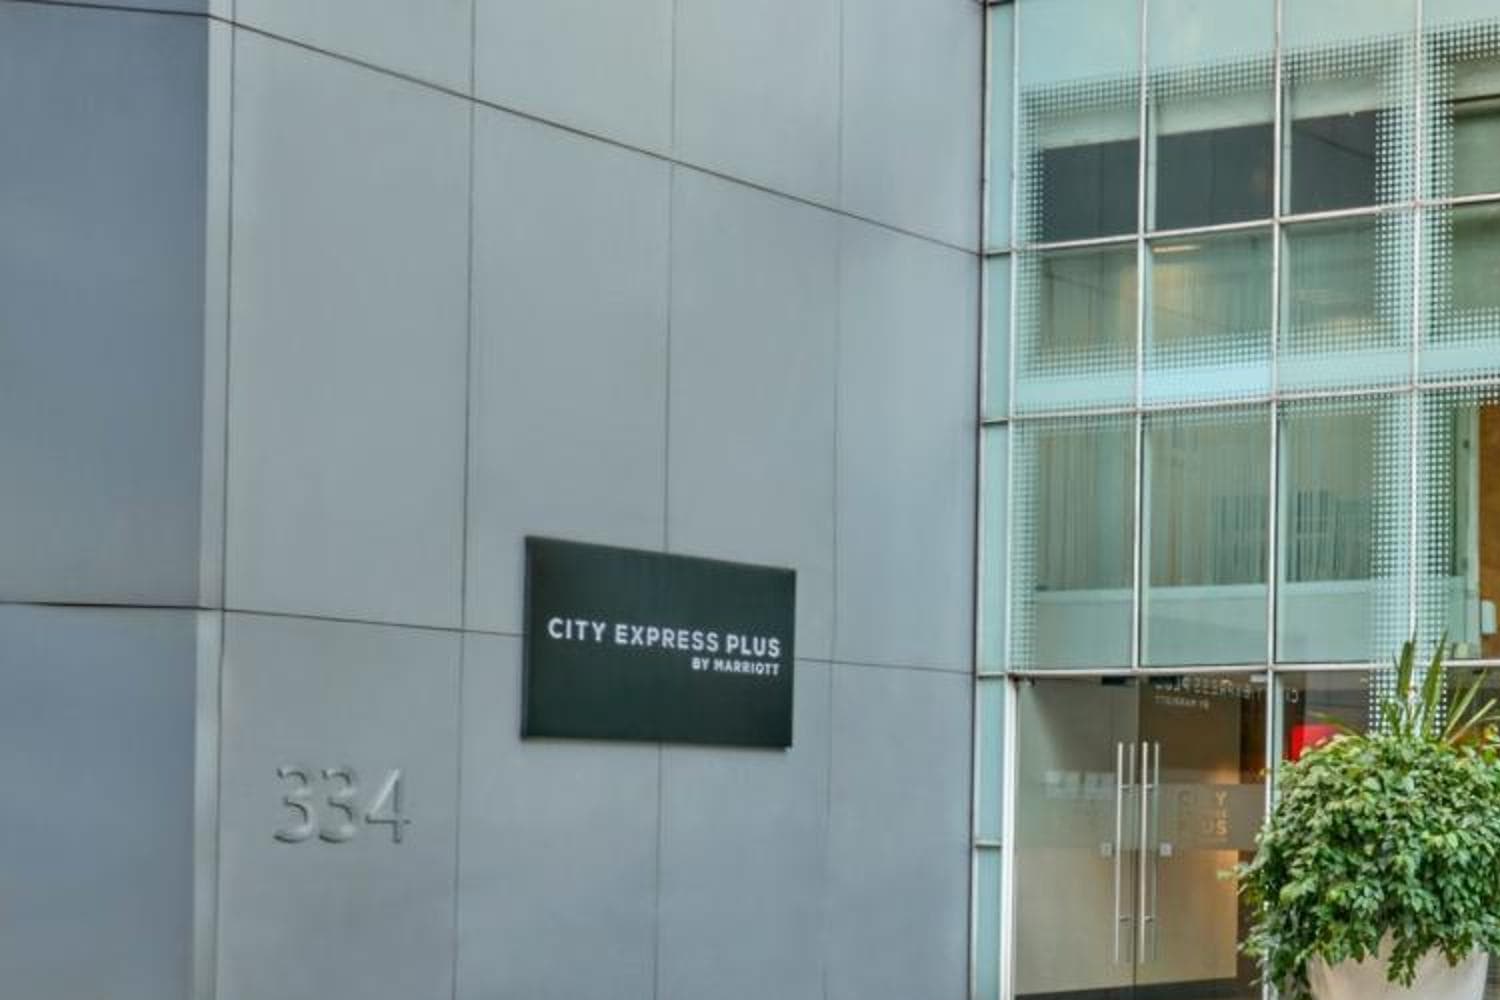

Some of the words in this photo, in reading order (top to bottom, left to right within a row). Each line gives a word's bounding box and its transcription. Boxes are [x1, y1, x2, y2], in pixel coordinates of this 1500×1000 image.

[547, 617, 606, 643] CITY
[615, 623, 719, 652] EXPRESS
[725, 634, 781, 658] PLUS
[691, 657, 709, 671] BY
[713, 659, 780, 676] MARRIOTT
[273, 767, 411, 844] 334
